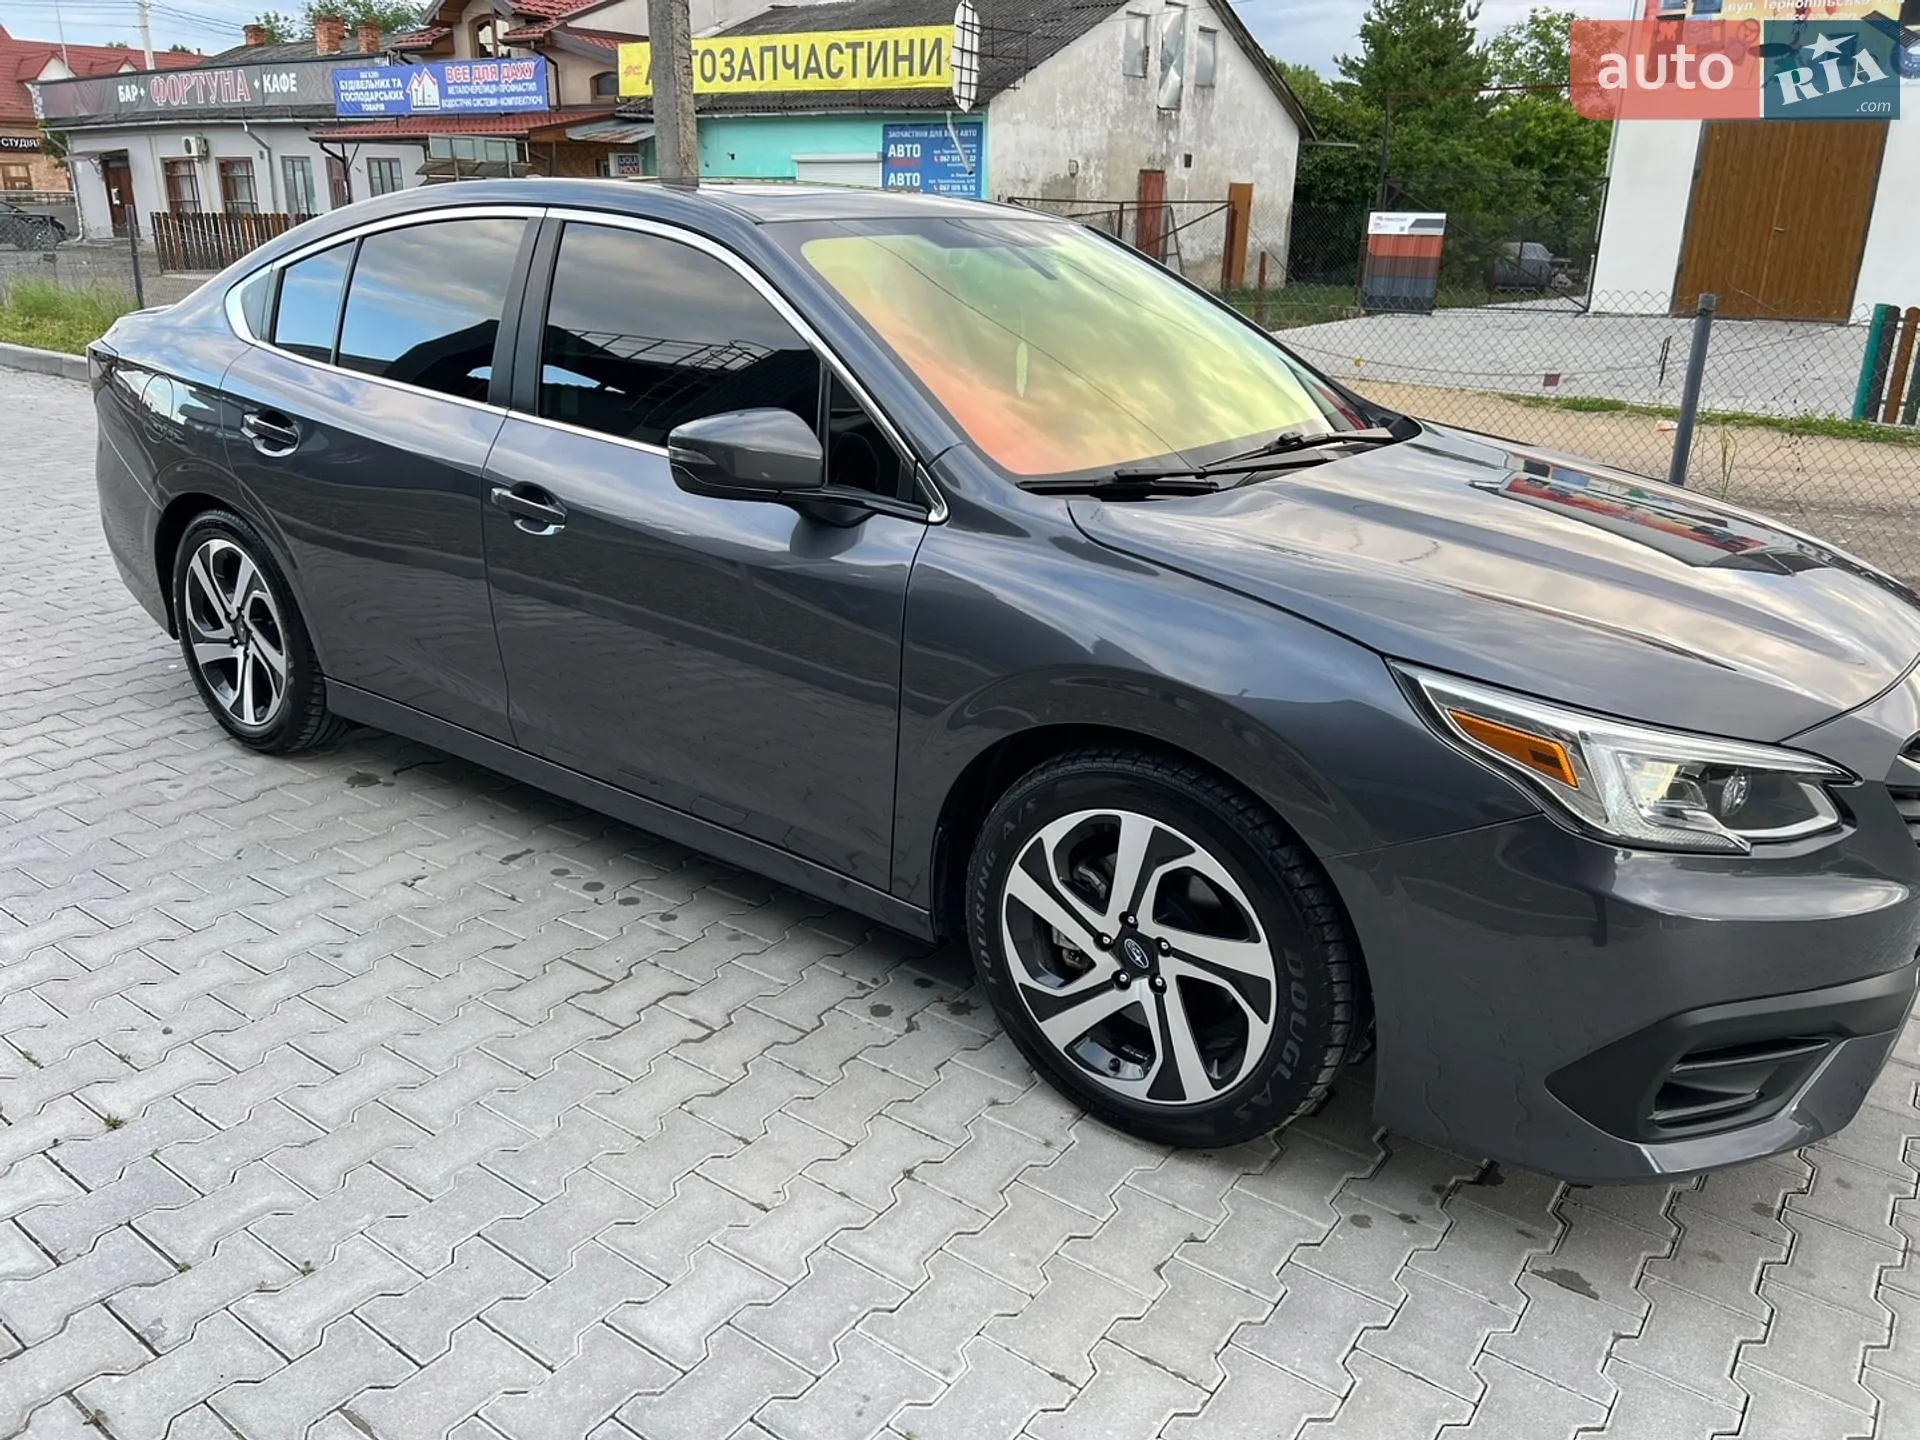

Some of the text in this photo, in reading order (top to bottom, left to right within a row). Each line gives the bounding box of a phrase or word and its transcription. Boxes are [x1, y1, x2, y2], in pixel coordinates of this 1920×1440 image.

[644, 37, 943, 86] ОЗАПЧАСТИНИ
[445, 61, 535, 84] ВСЕ ДЛЯ ДАХУ
[117, 69, 298, 106] БАР ФОРТУНА КАФЕ
[392, 77, 403, 89] ТА
[340, 90, 404, 102] ГОСПОДАРСЬКИХ
[960, 129, 977, 137] АВТО
[1, 137, 37, 148] СТУДІЯ
[888, 143, 921, 158] АВТО
[888, 172, 921, 187] АВТО
[974, 847, 998, 986] TOURING
[1233, 948, 1309, 1124] DOUGLAS
